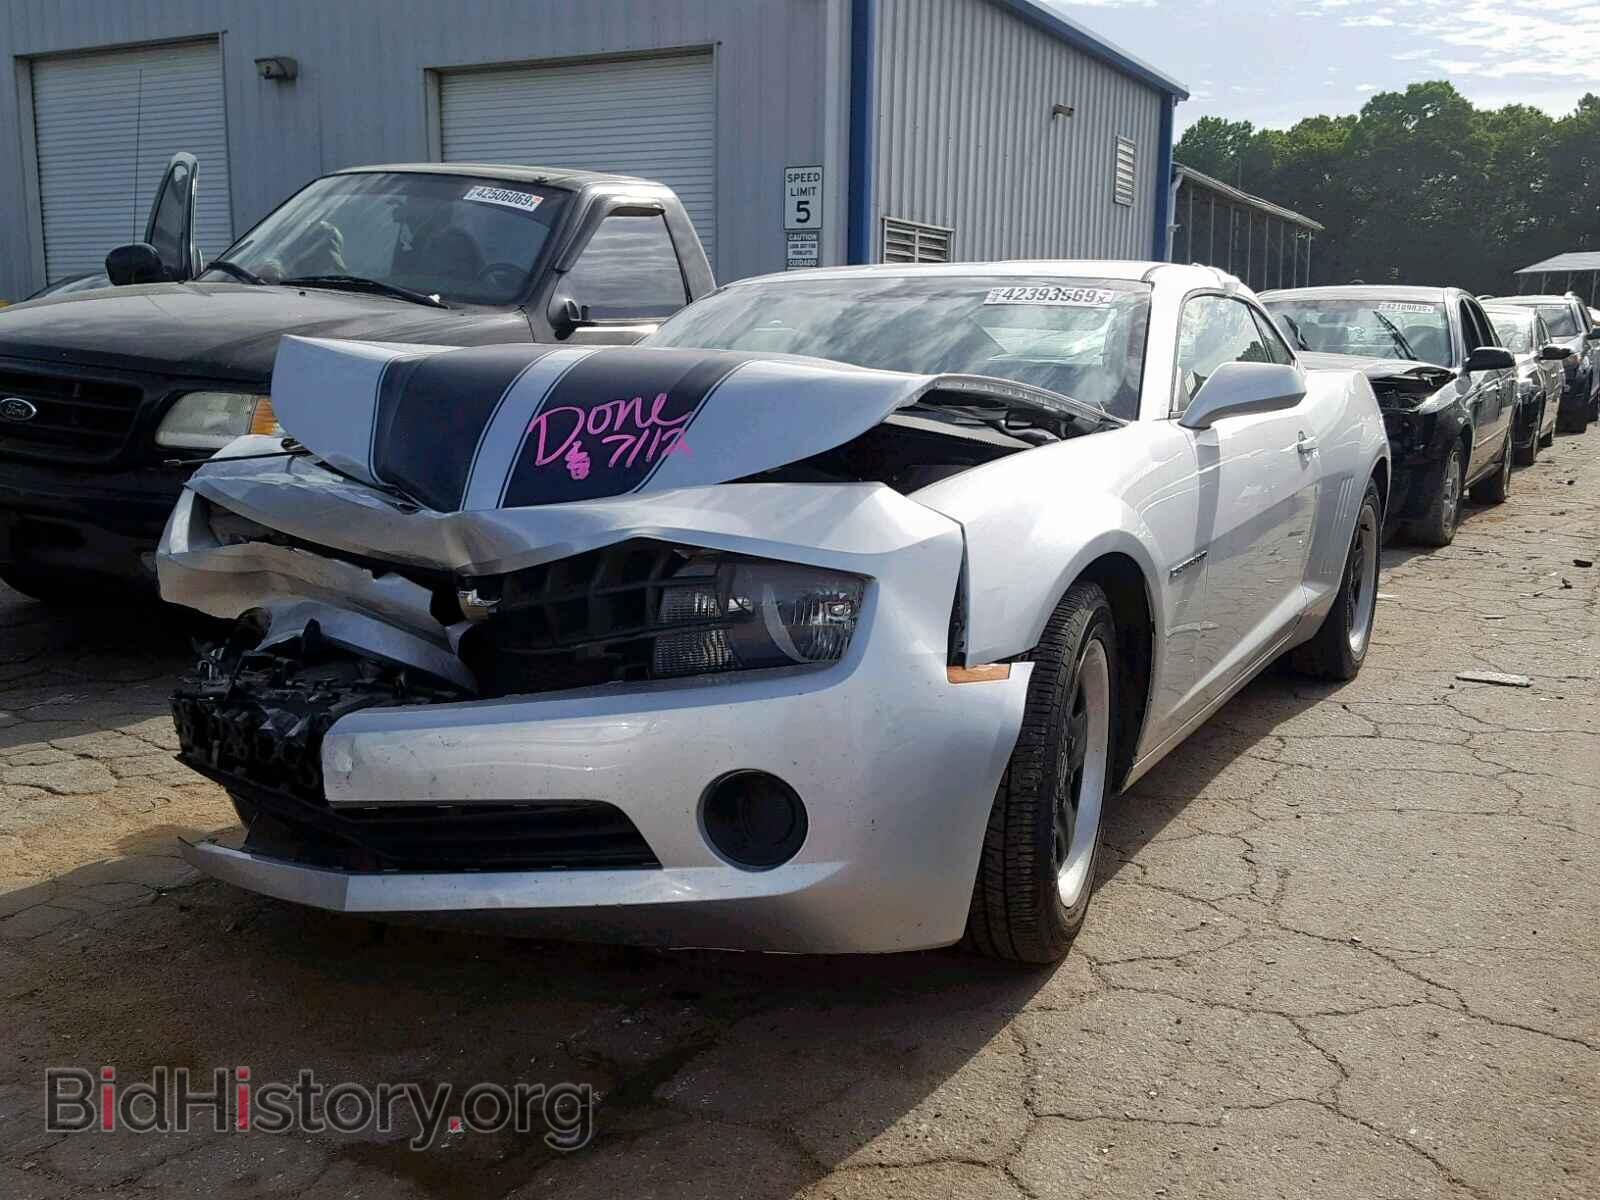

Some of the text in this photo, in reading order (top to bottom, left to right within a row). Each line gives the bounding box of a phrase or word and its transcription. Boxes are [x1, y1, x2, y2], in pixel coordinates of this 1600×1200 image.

[787, 172, 820, 183] SPEED
[790, 187, 817, 197] LIMIT
[795, 200, 811, 223] 5
[528, 393, 695, 466] Done
